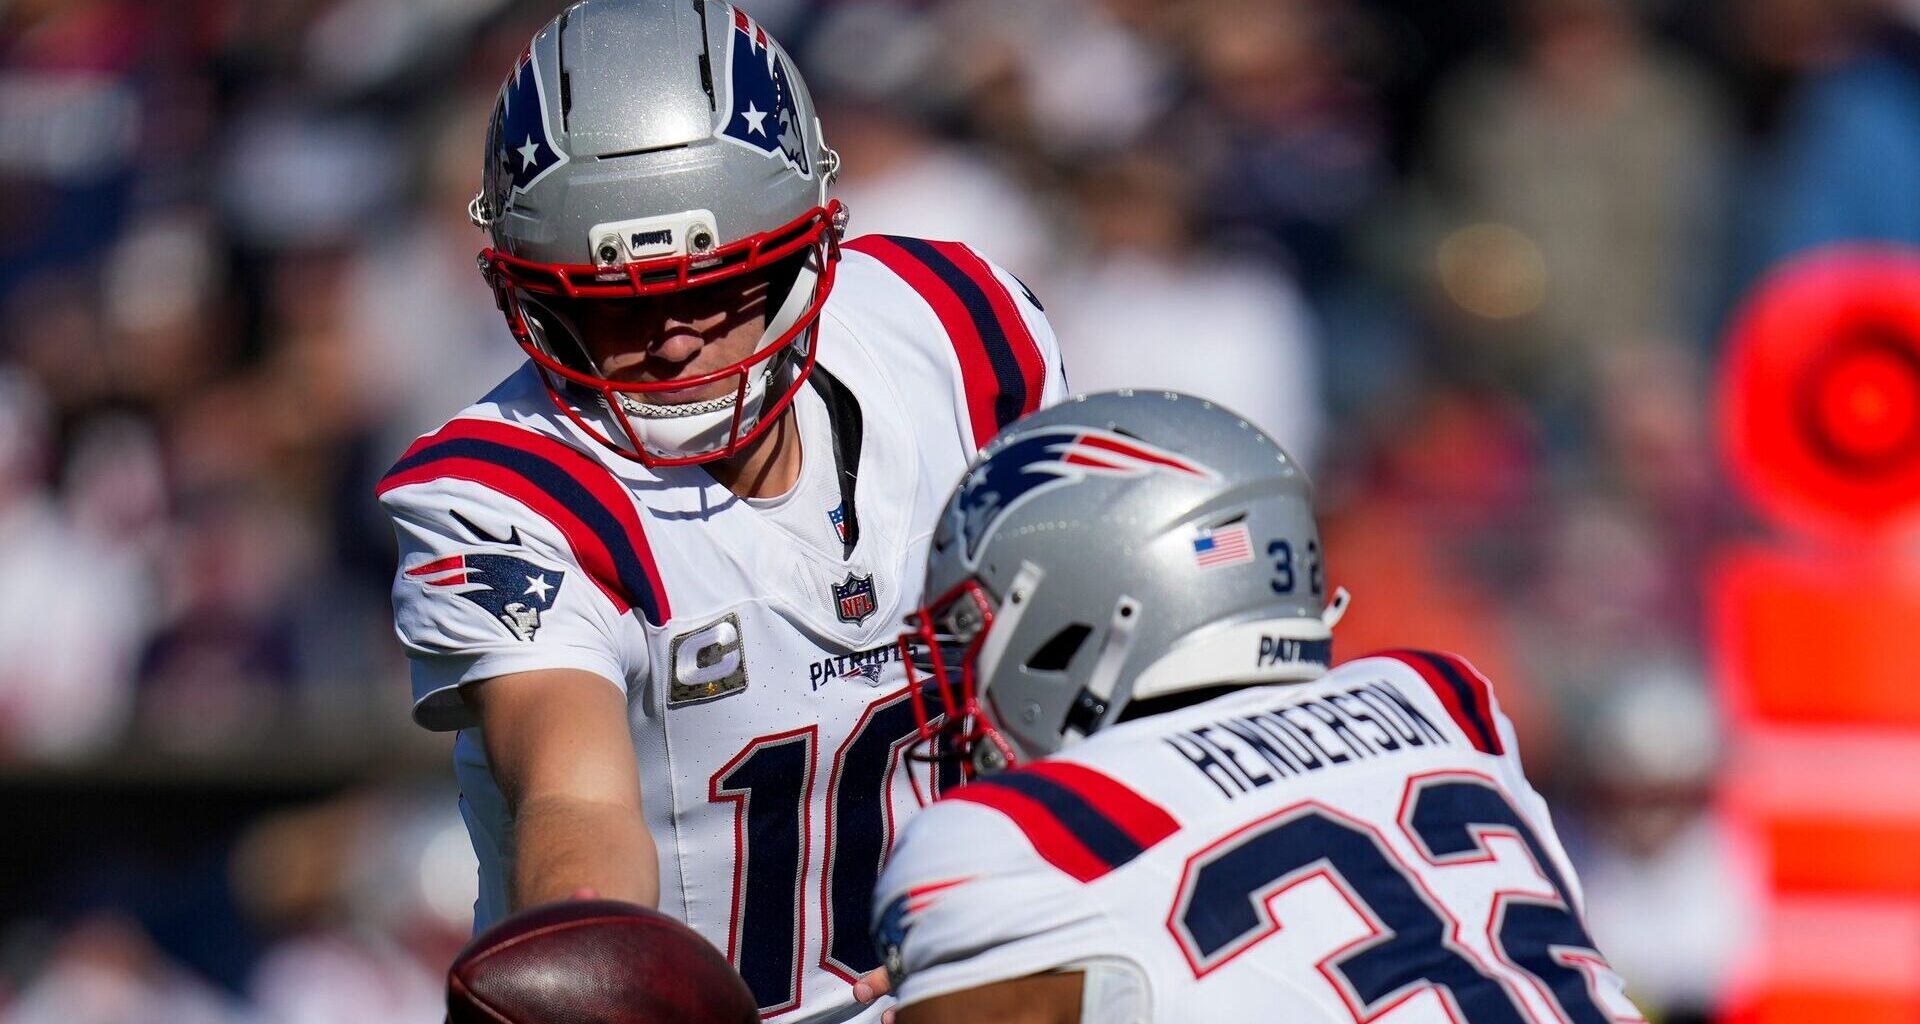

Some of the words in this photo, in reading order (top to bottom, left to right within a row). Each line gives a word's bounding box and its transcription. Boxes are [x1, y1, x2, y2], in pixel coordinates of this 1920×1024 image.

[676, 622, 741, 686] C
[841, 596, 872, 618] NFL
[1163, 681, 1448, 800] HENDERSON
[709, 674, 968, 1019] 10
[1166, 768, 1648, 1024] 32
